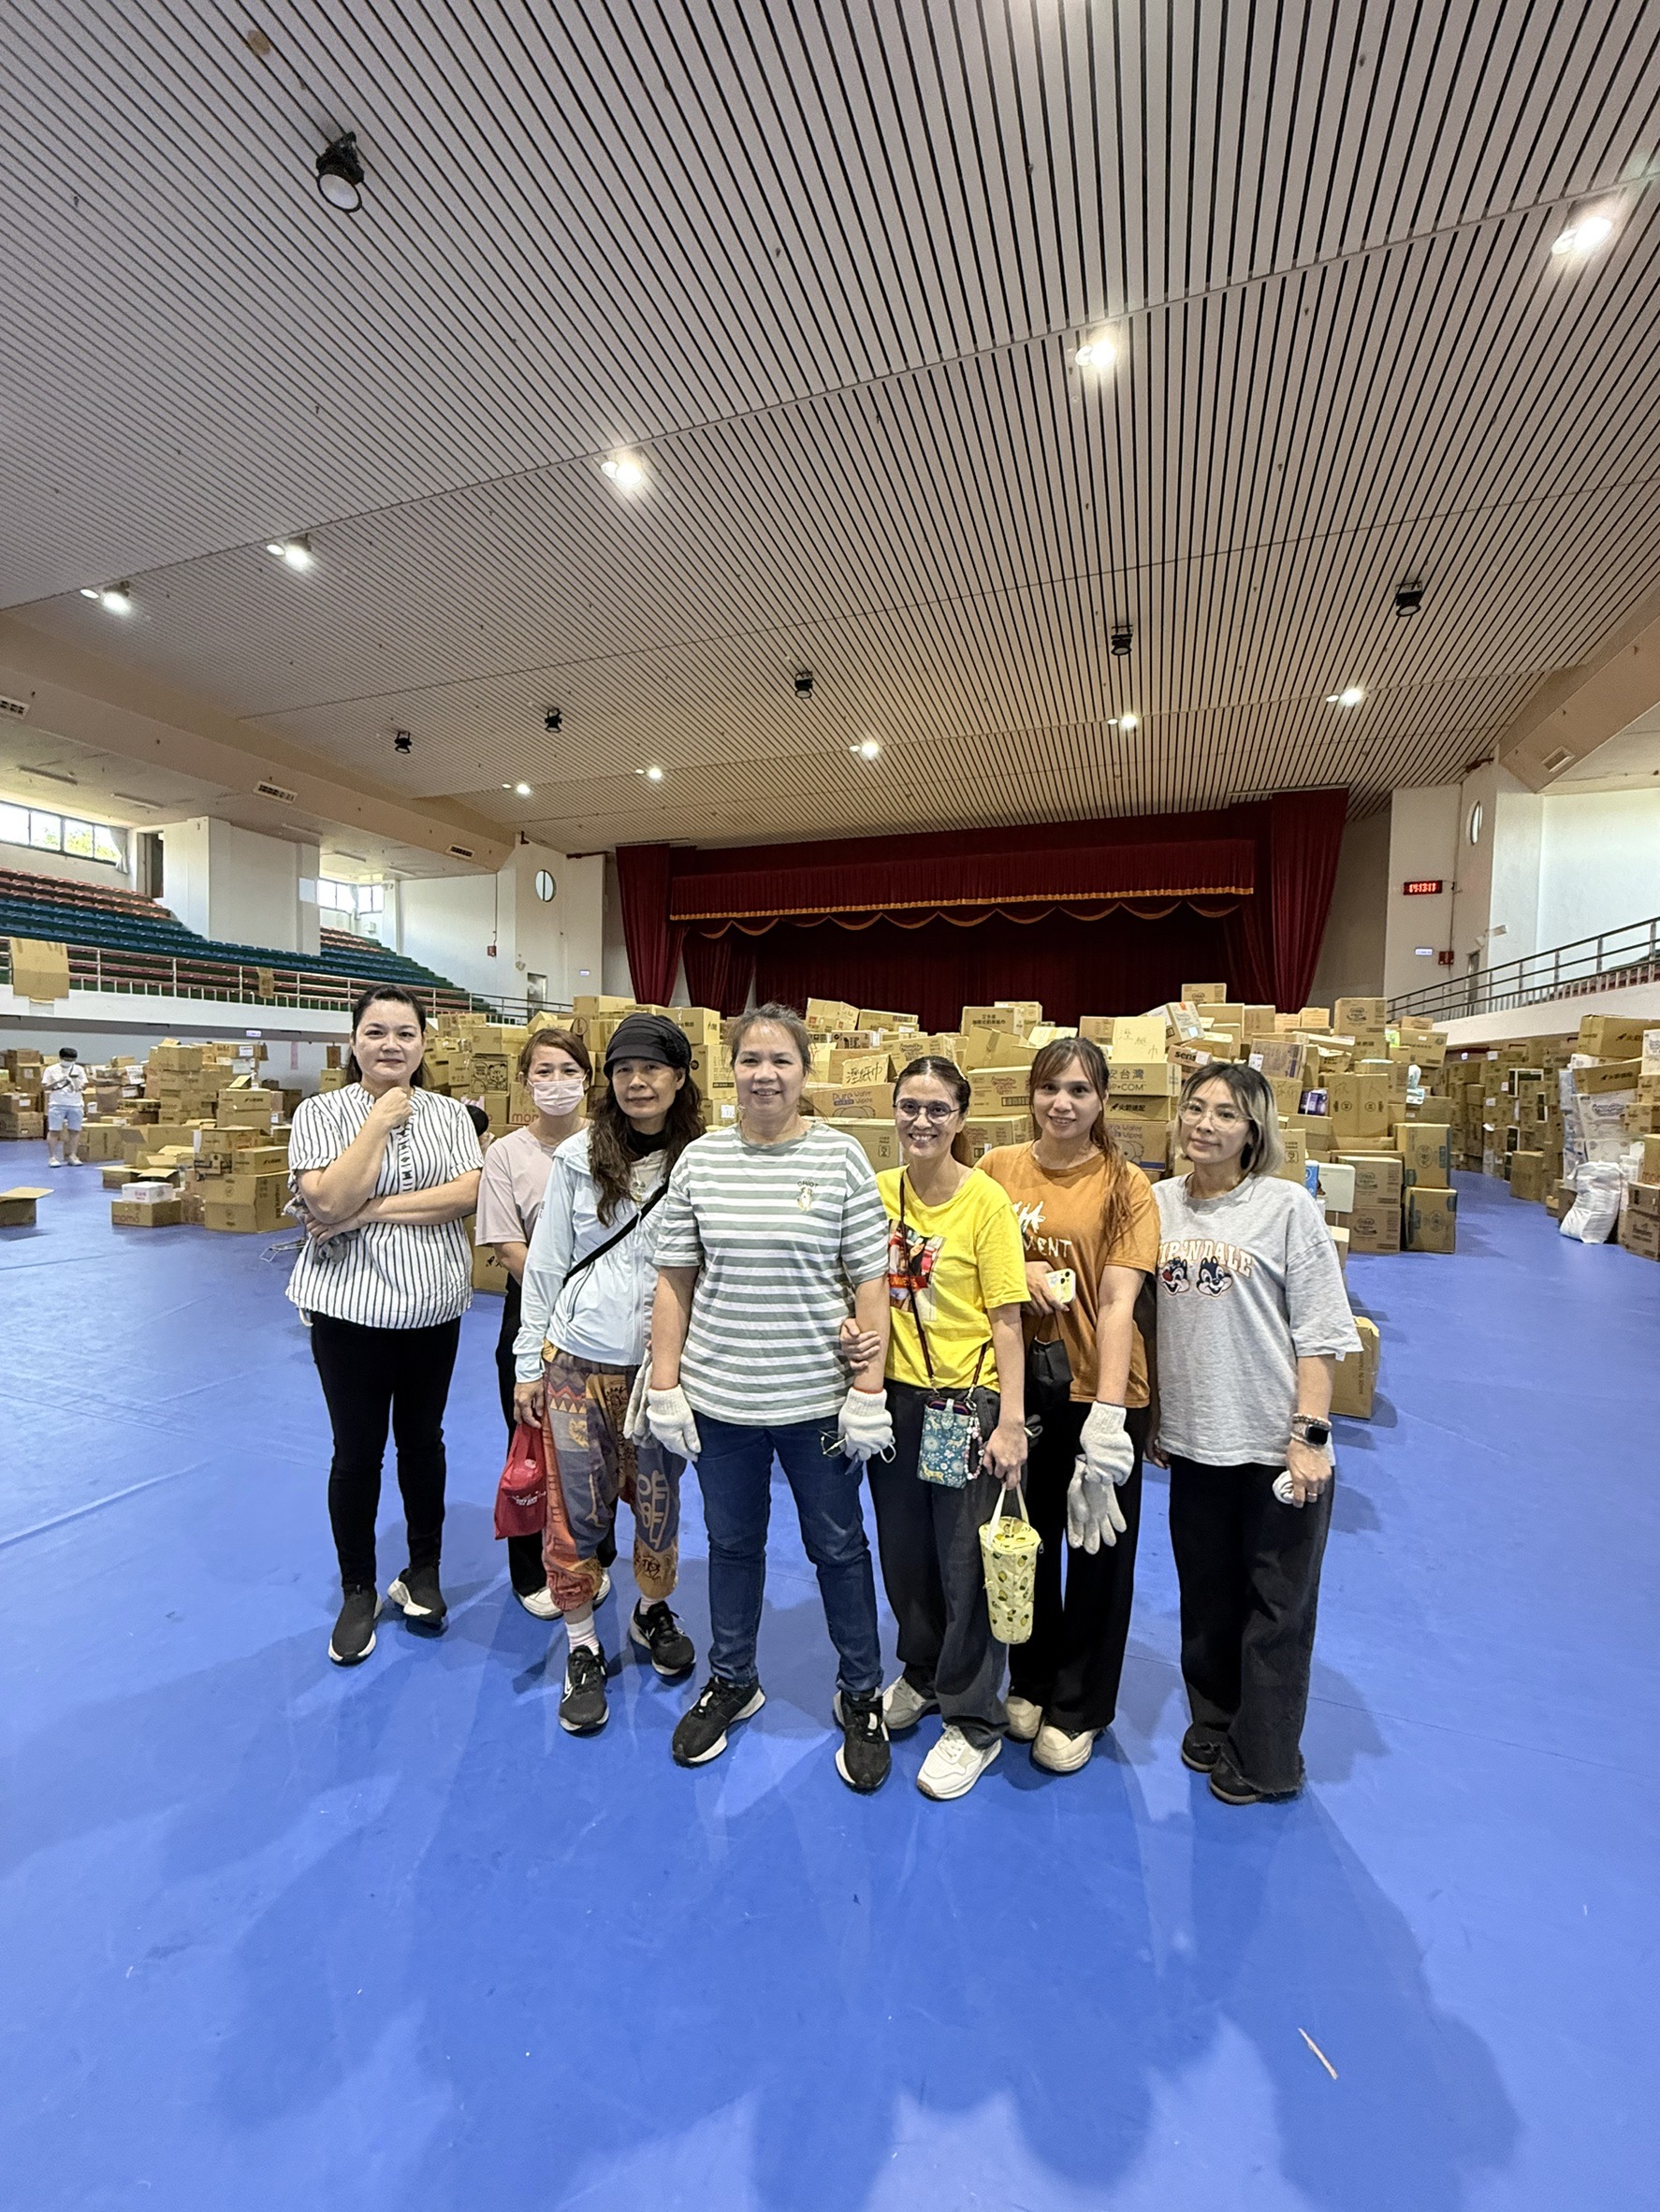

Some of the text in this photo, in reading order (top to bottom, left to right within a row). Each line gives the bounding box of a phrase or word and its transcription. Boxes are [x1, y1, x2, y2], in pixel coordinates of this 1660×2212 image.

[1109, 1068, 1144, 1080] 安台灣
[1201, 1238, 1253, 1278] DALE
